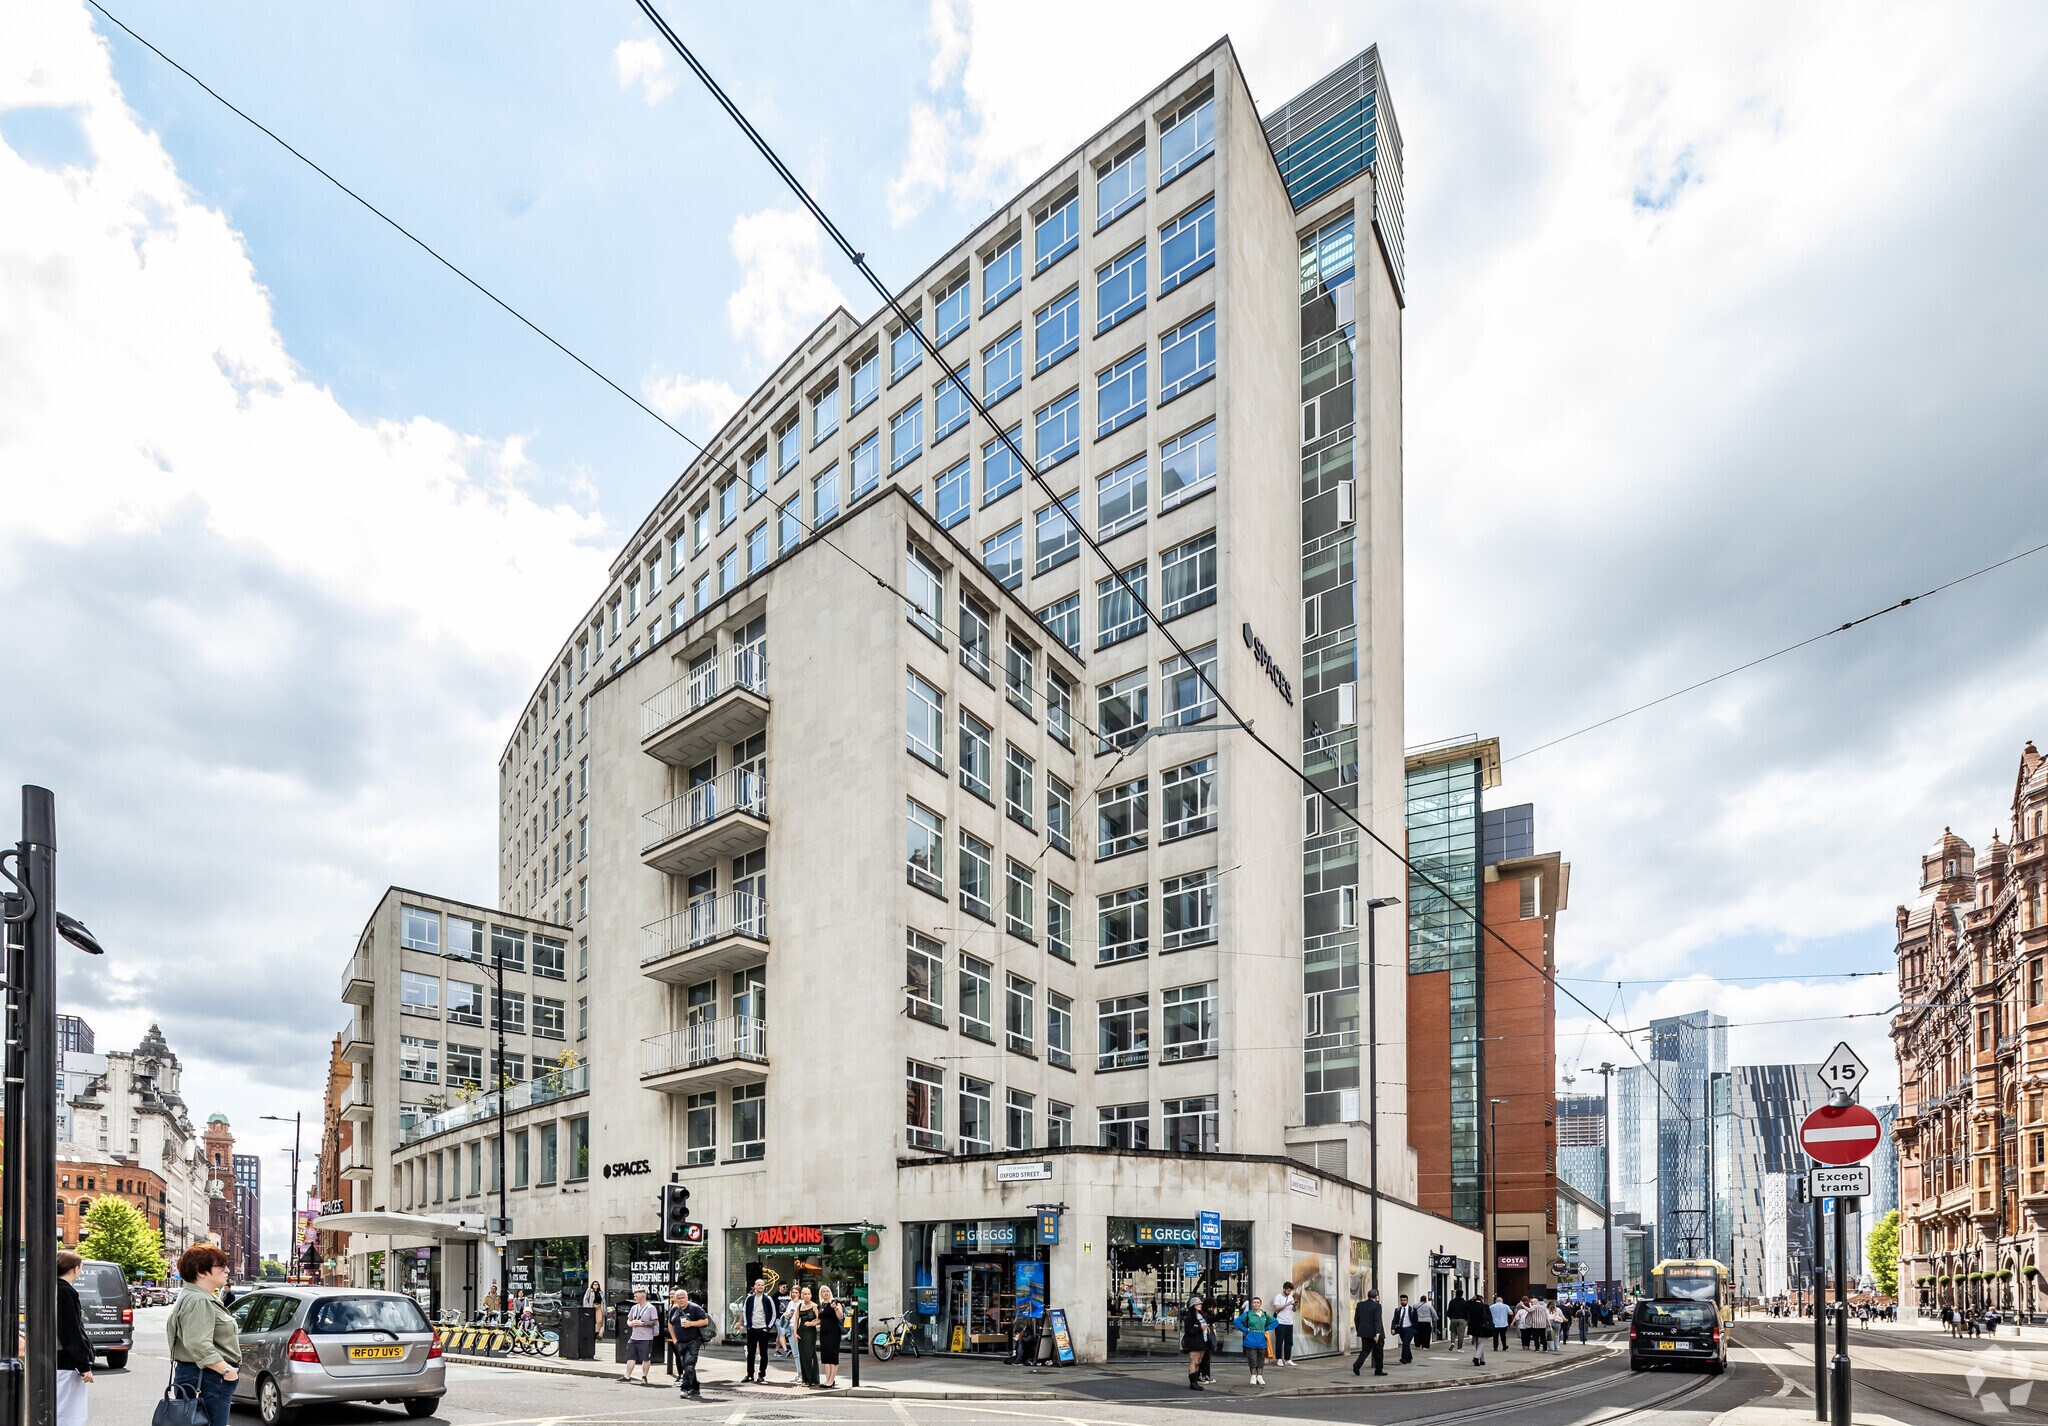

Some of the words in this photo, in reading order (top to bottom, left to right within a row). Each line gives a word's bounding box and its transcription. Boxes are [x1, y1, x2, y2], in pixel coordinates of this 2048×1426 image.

[1830, 1064, 1856, 1080] 15
[1817, 1171, 1864, 1182] Except
[1820, 1183, 1860, 1192] trams
[967, 1228, 1013, 1241] GREGGS
[1154, 1228, 1196, 1241] GREG
[631, 1261, 648, 1271] LET'S
[649, 1261, 669, 1271] START
[631, 1273, 662, 1283] REDEFINE
[651, 1284, 658, 1294] IS
[354, 1348, 380, 1358] RF07
[381, 1347, 400, 1357] UVS
